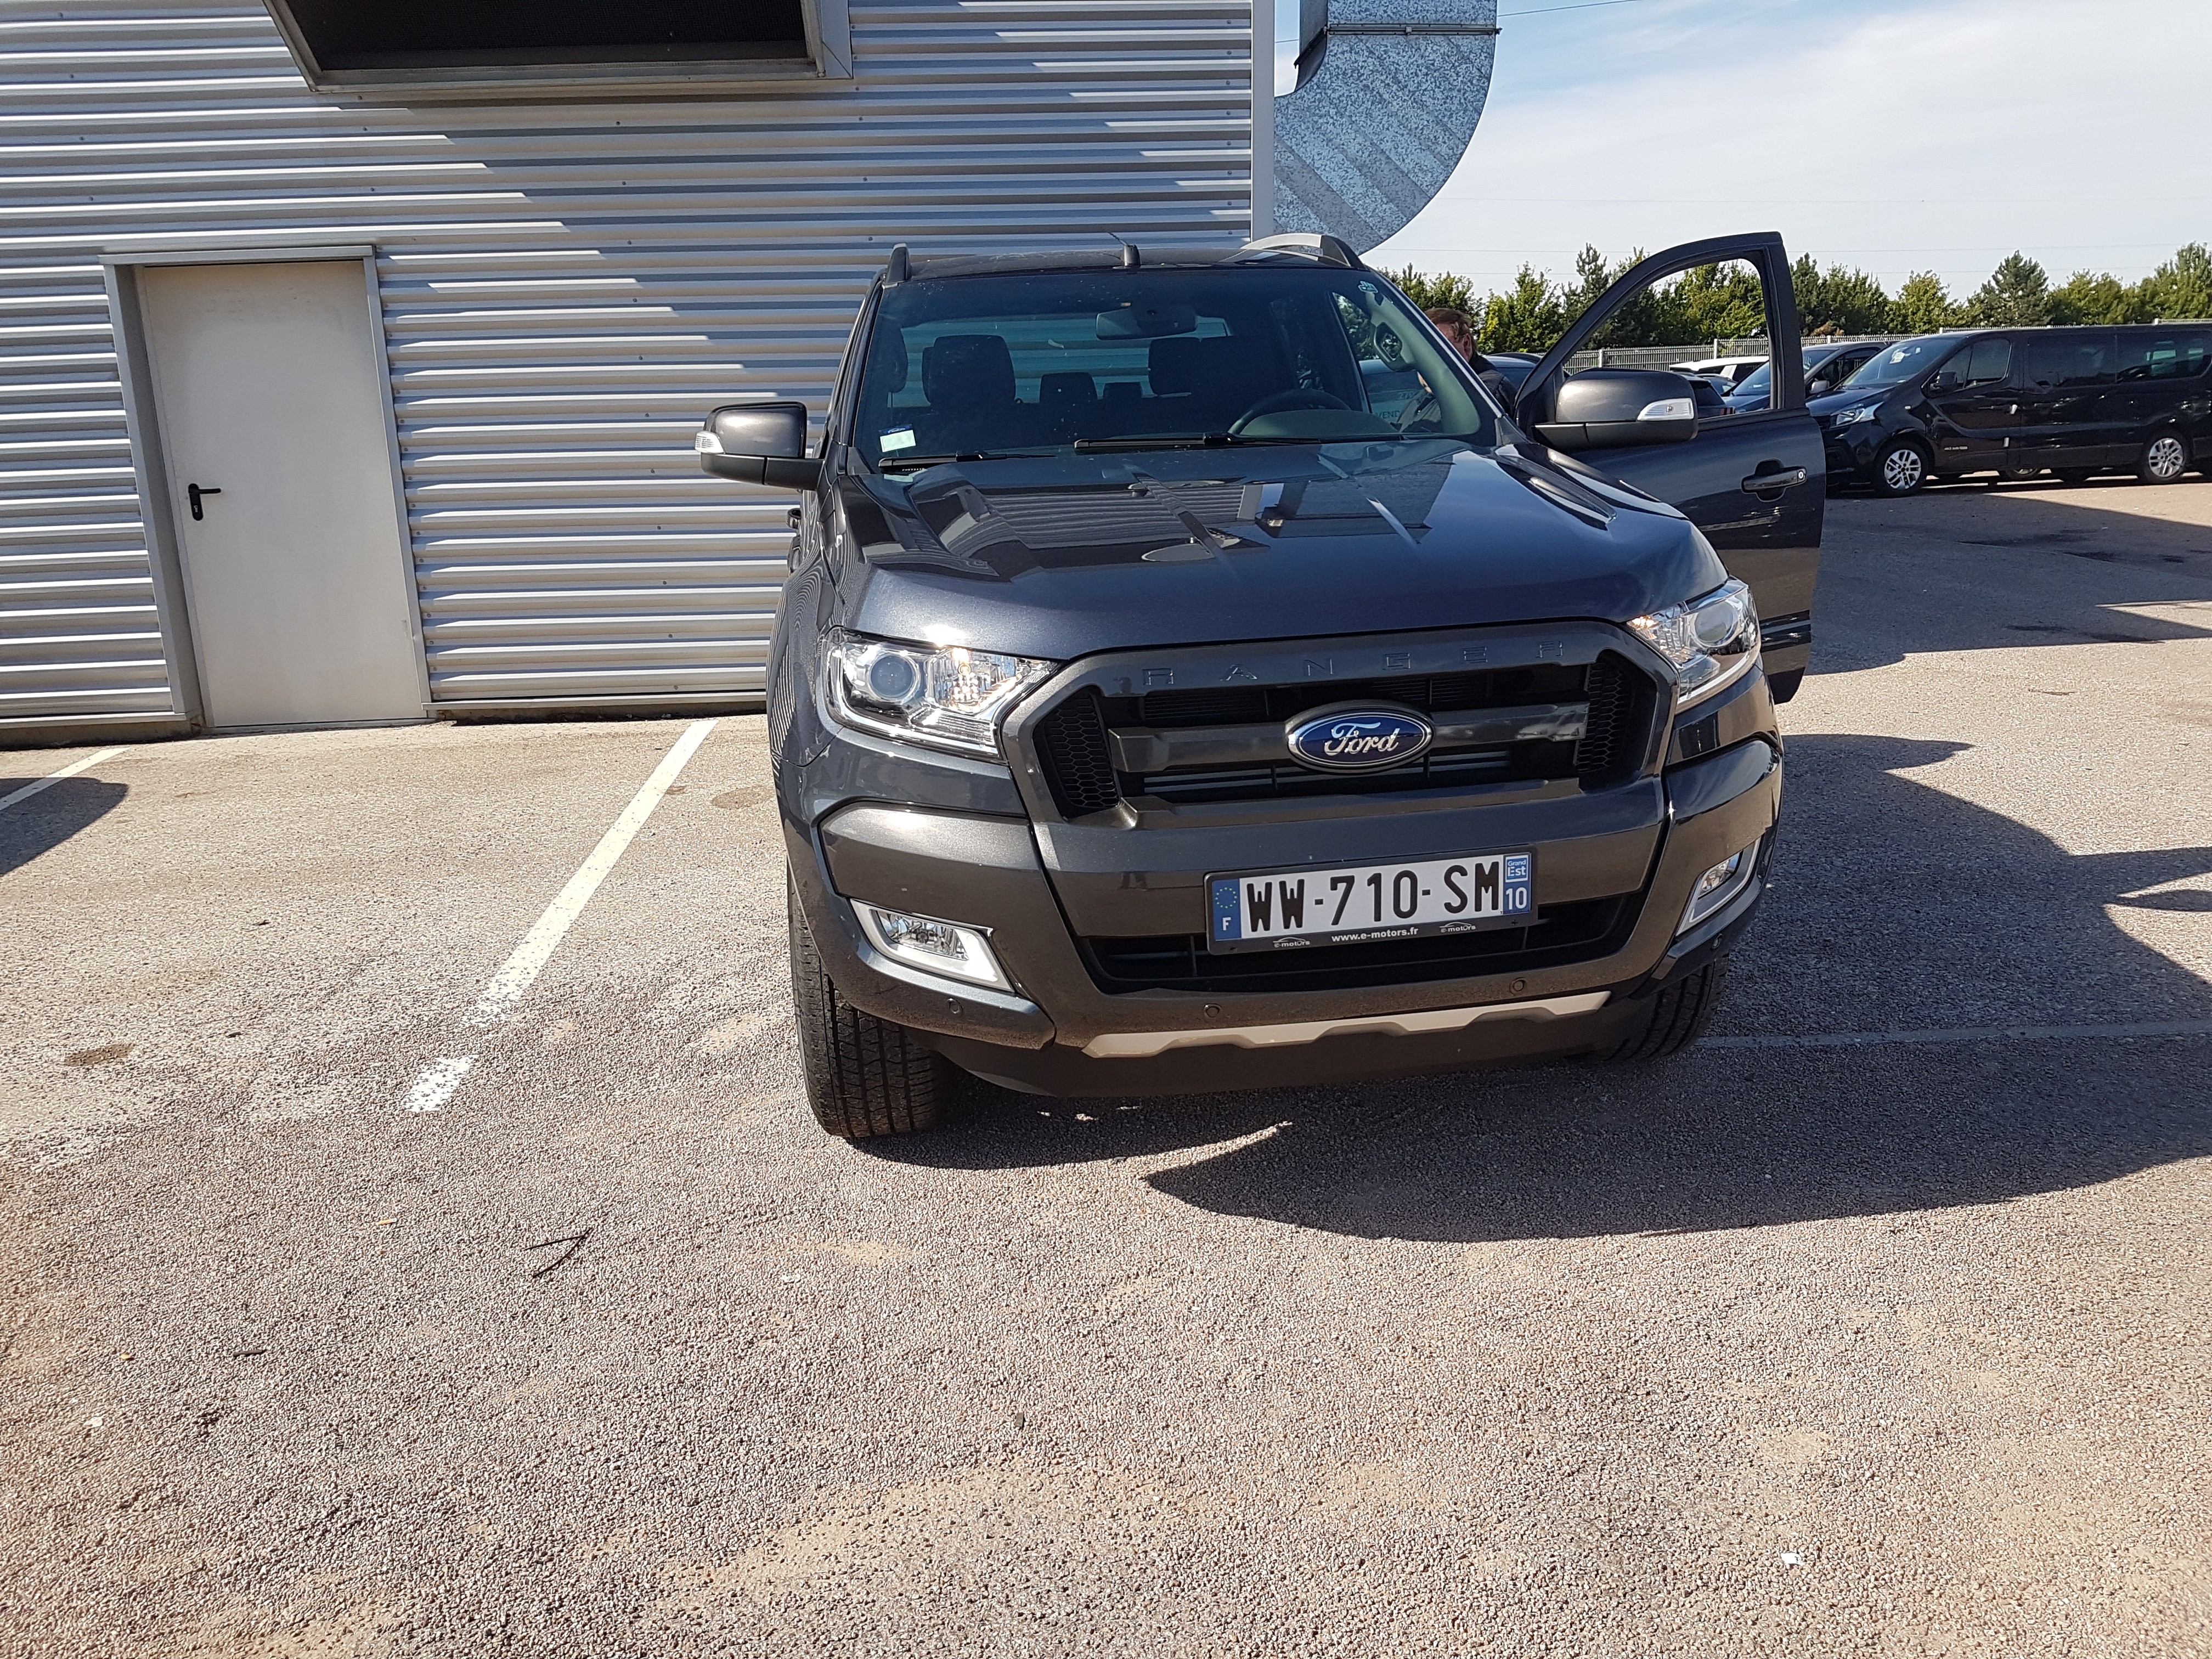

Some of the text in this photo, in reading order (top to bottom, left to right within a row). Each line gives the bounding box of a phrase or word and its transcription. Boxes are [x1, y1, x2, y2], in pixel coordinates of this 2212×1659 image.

[1142, 641, 1564, 686] RANGER
[1324, 722, 1401, 756] Ford
[1508, 866, 1526, 877] Est
[1246, 861, 1499, 932] WW-710-SM
[1505, 887, 1527, 910] 10
[1222, 917, 1232, 931] F
[1331, 927, 1419, 943] www.e-motors.fr
